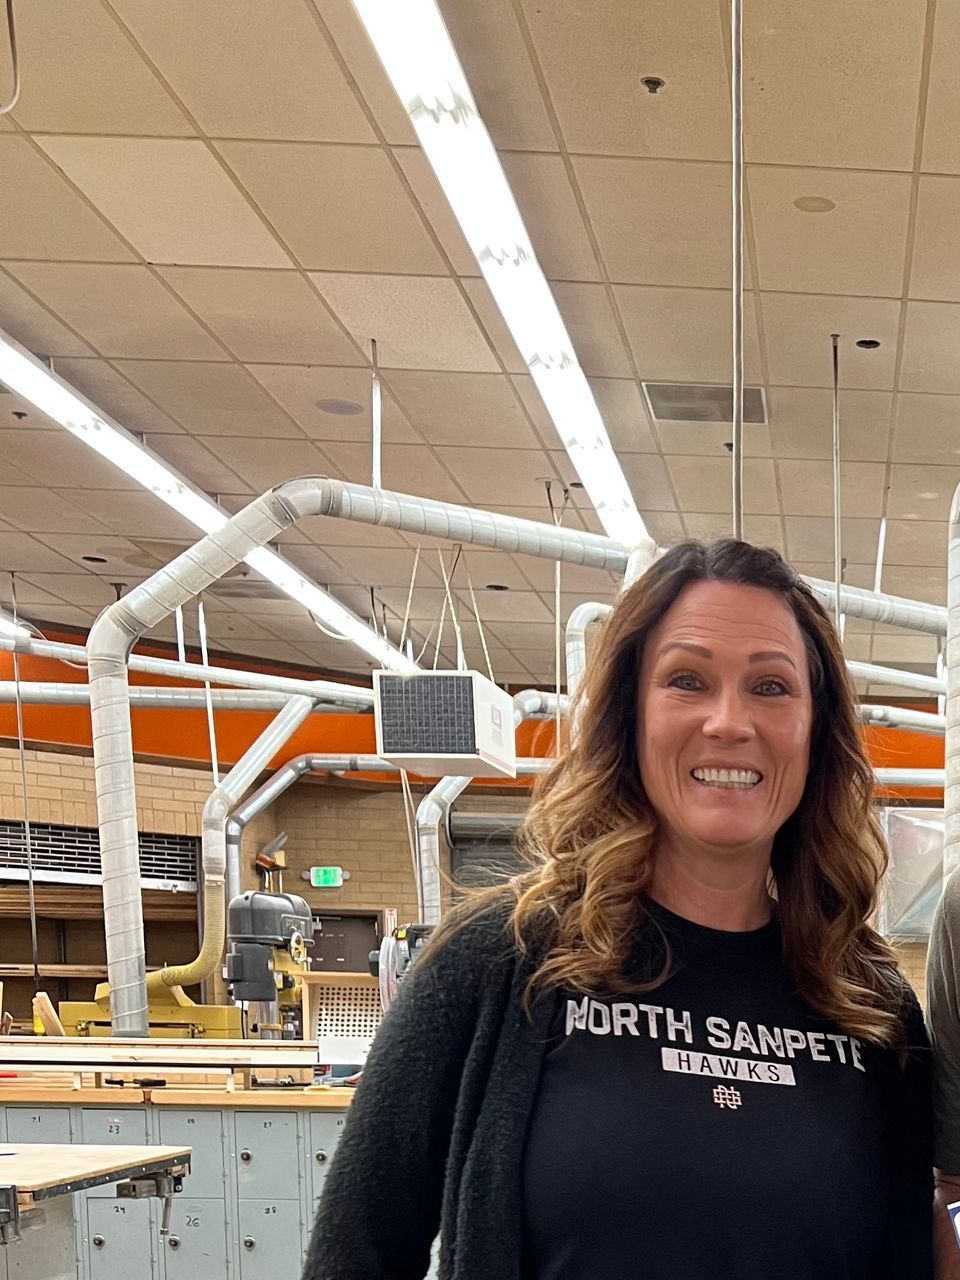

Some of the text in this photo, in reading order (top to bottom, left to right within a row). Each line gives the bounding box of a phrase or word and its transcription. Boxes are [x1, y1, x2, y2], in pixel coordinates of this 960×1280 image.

[565, 996, 866, 1073] NORTH SANPETE
[677, 1052, 781, 1083] HAWKS
[108, 1125, 120, 1134] 23
[113, 1205, 126, 1214] 24
[185, 1215, 200, 1228] 26
